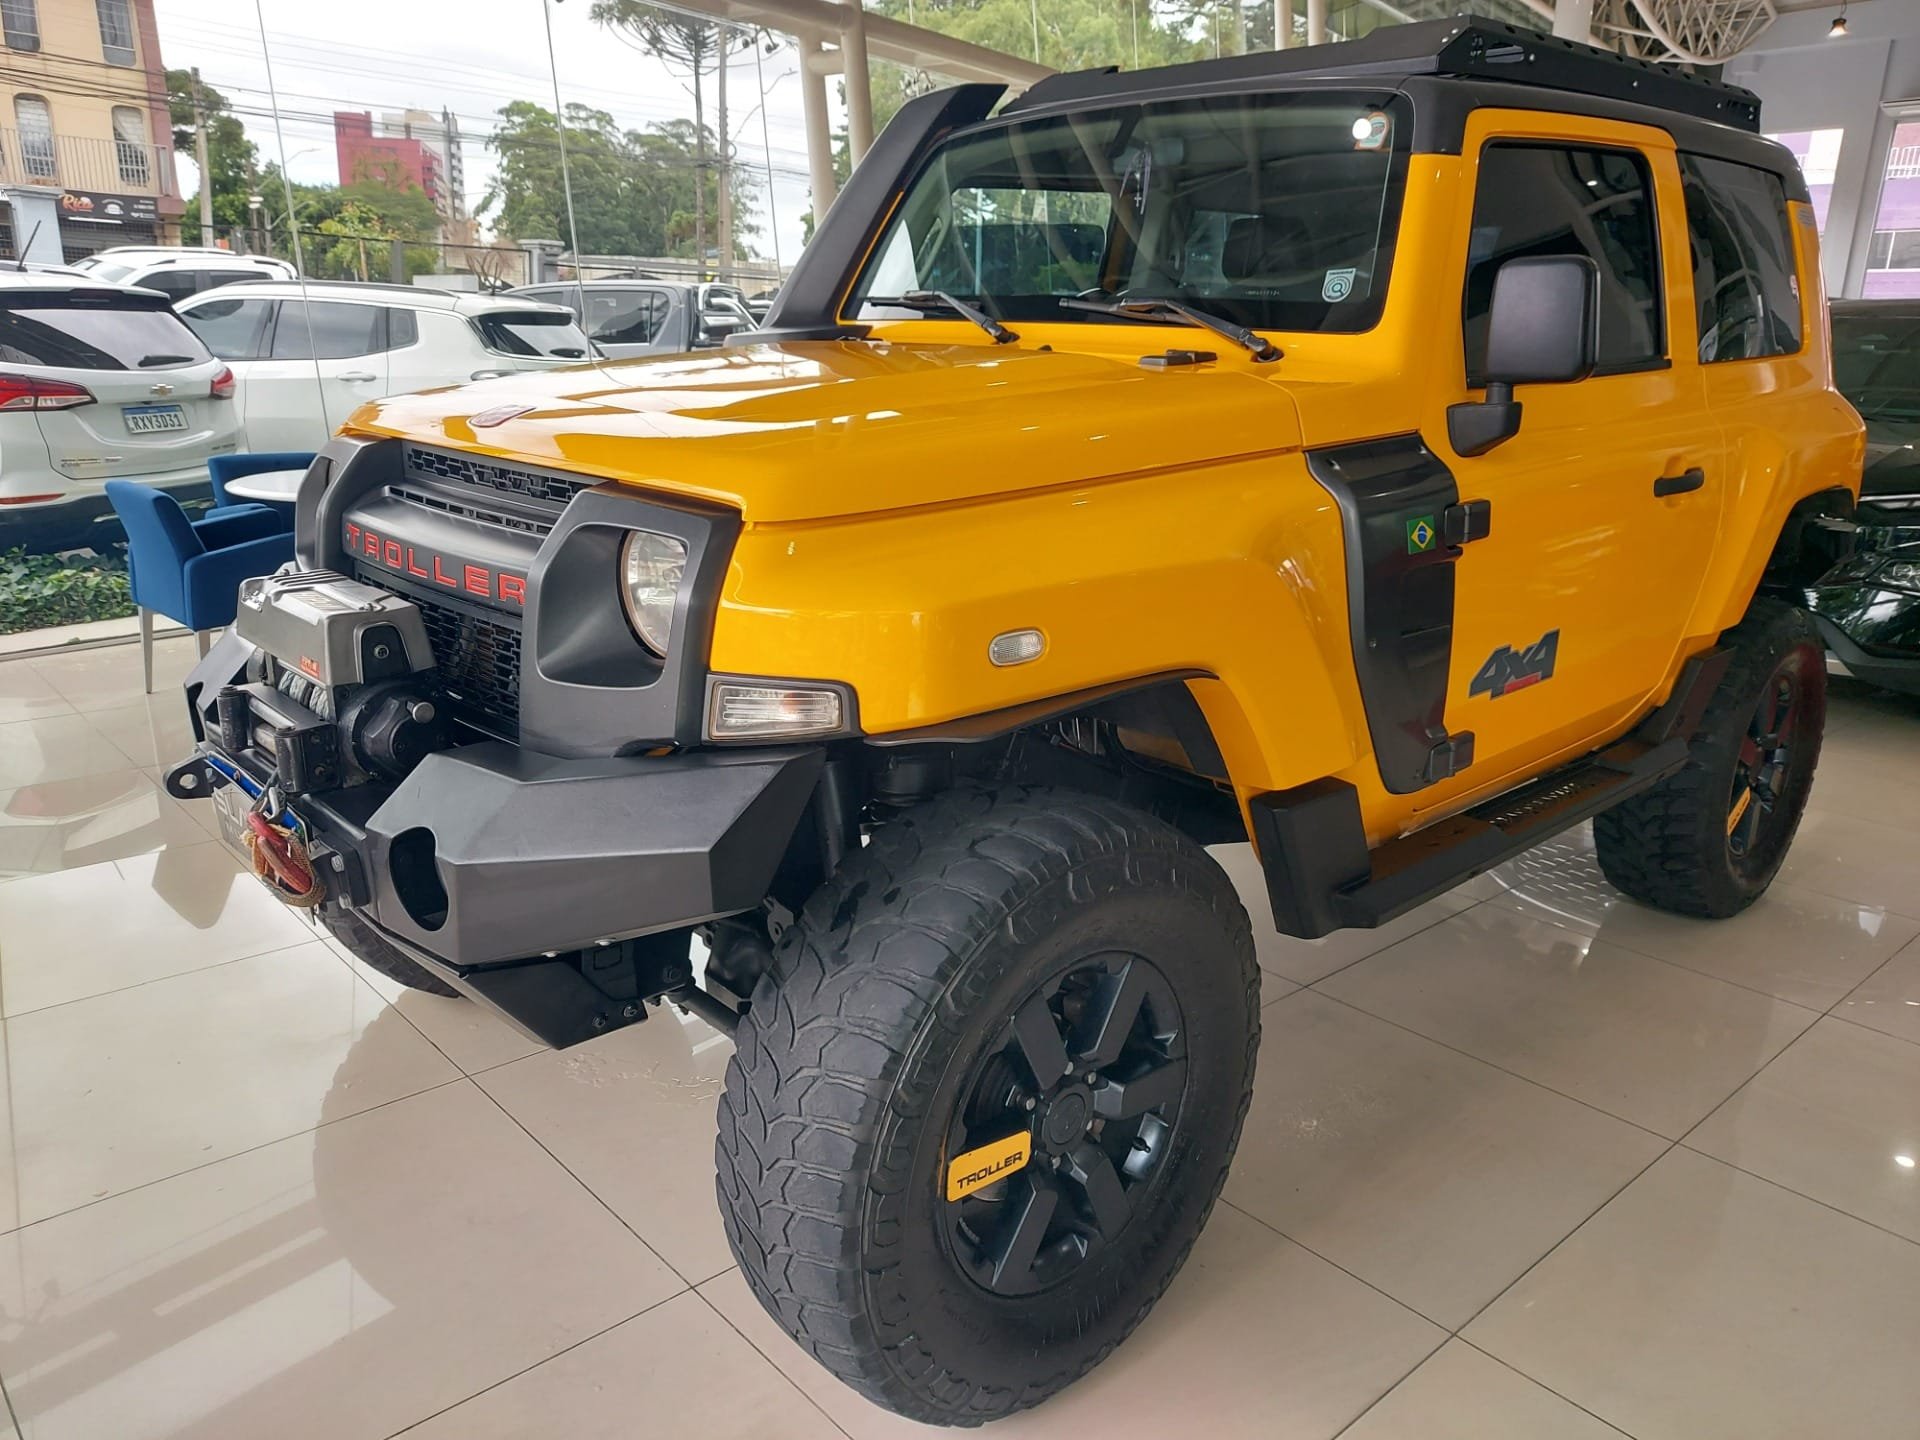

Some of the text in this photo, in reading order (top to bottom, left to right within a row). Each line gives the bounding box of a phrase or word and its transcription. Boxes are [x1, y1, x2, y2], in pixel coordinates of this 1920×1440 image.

[131, 413, 183, 430] RXY3D31
[345, 523, 527, 606] TROLLER
[957, 1150, 1023, 1189] TROLLER
